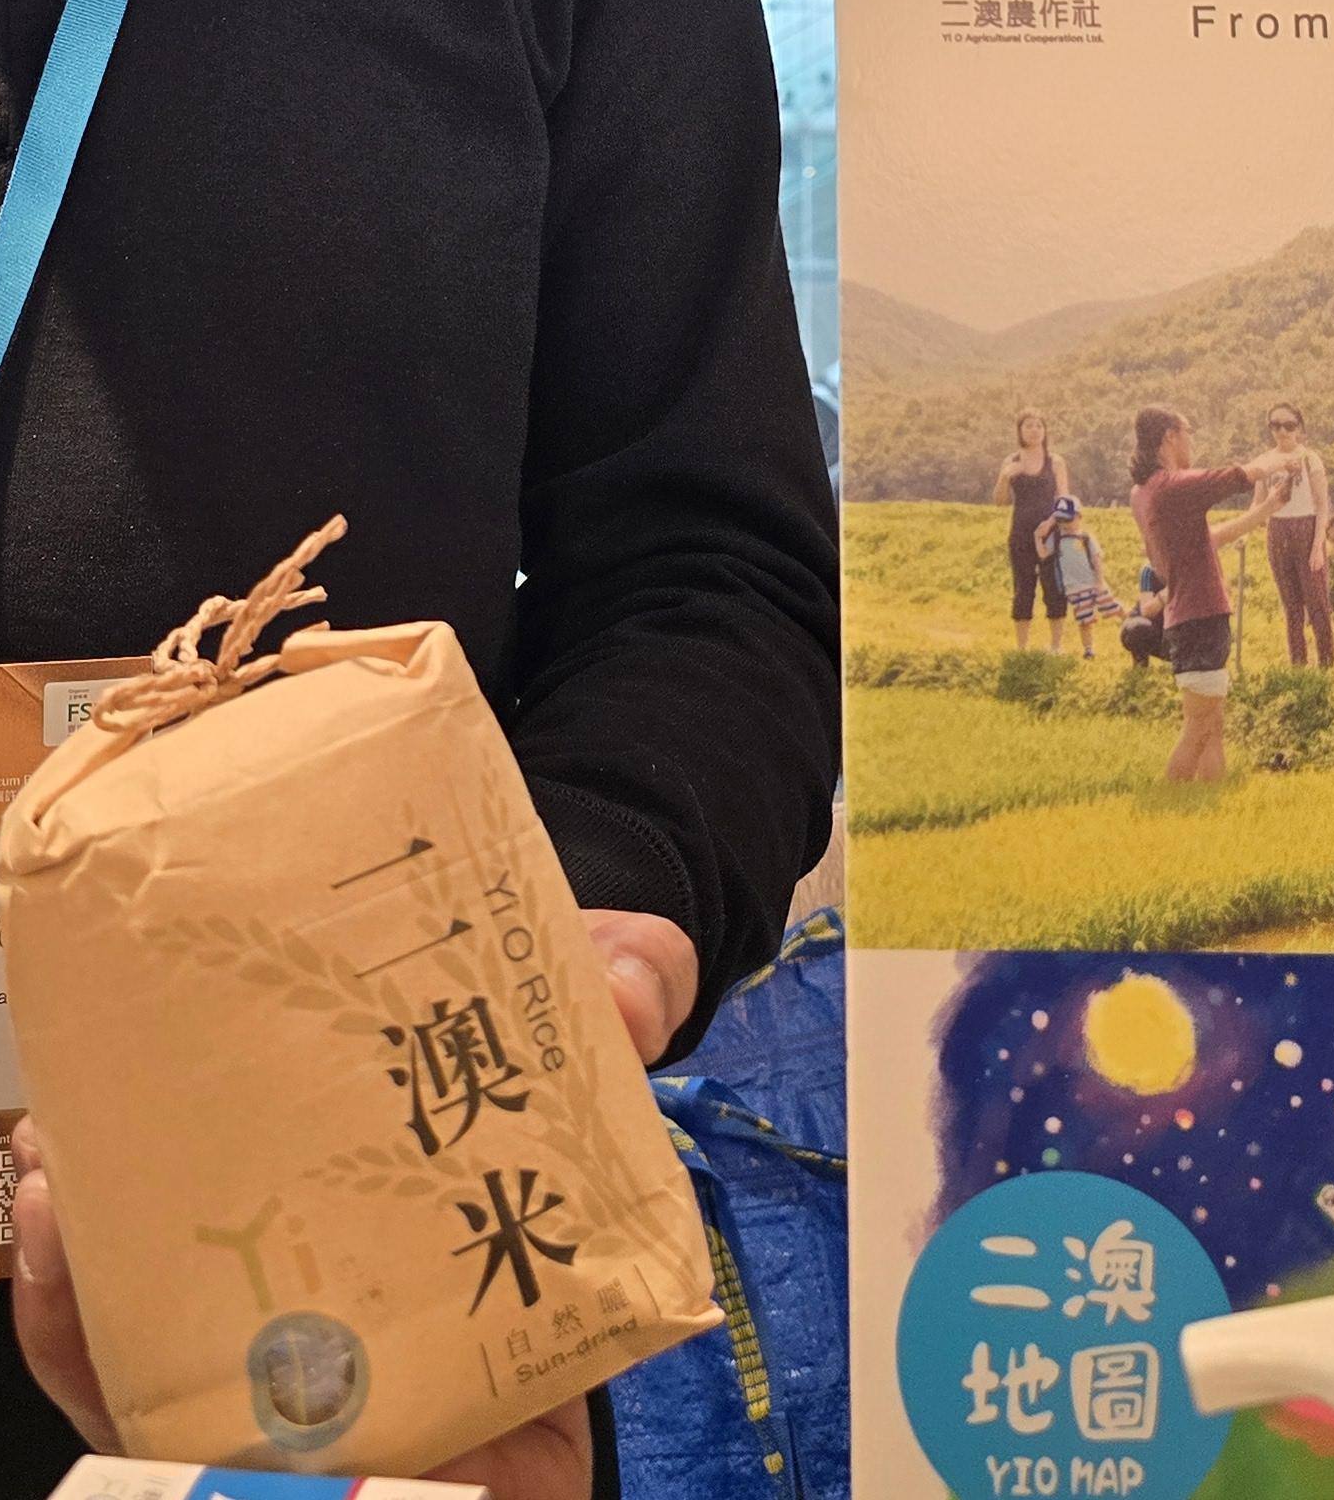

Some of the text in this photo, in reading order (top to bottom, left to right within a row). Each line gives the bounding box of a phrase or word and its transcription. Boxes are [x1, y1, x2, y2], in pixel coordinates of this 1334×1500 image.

[1192, 5, 1329, 40] From
[517, 972, 565, 1073] Rice
[970, 1219, 1158, 1326] 二澳
[516, 1313, 638, 1383] Sun-dried
[962, 1341, 1161, 1442] 地圖
[986, 1454, 1146, 1497] YIO MAP
